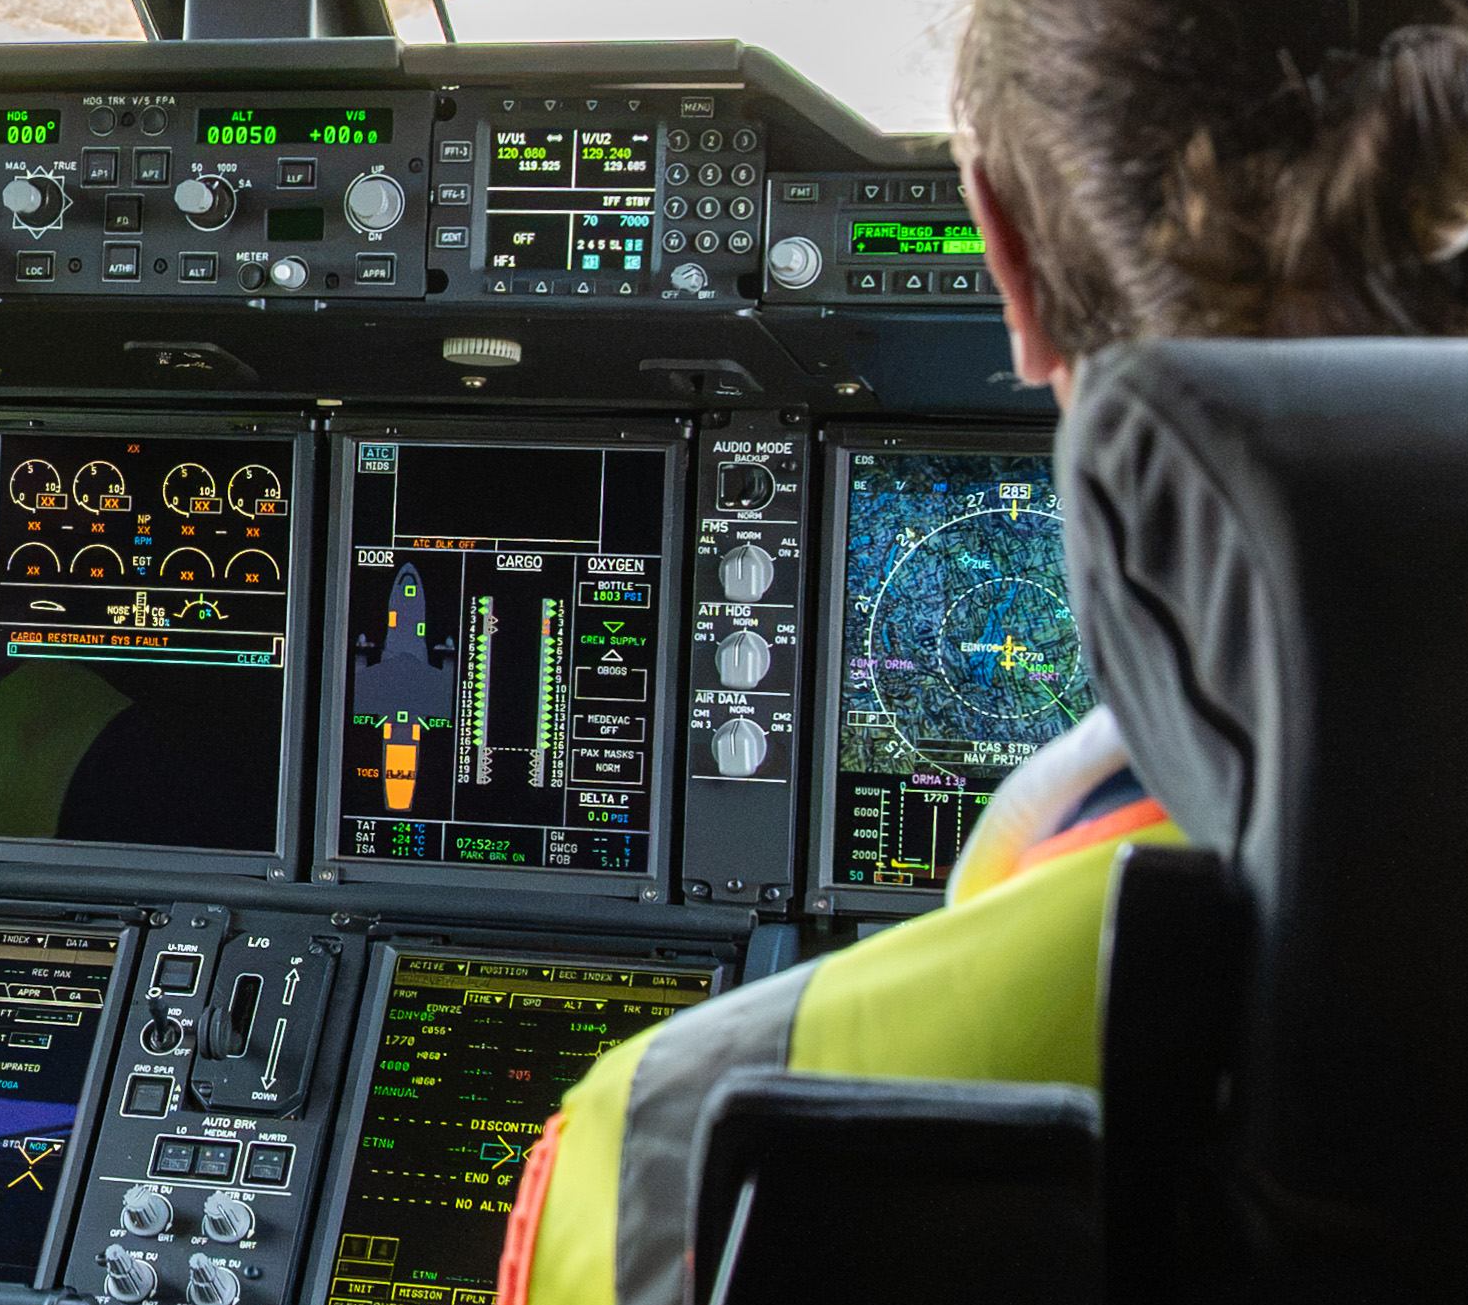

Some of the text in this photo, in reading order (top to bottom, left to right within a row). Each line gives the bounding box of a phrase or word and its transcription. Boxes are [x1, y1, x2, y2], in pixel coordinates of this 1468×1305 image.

[7, 110, 28, 122] HDG
[232, 111, 254, 122] ALT
[346, 110, 366, 121] V/S
[207, 126, 277, 144] 00050
[497, 133, 526, 144] V/U1
[582, 133, 612, 145] V/U2
[582, 148, 632, 160] 129.240
[53, 160, 77, 171] TRUE
[620, 214, 650, 228] 7000
[513, 233, 535, 245] OFF
[236, 251, 269, 263] METER
[494, 255, 516, 268] HF1
[367, 448, 389, 459] ATC
[713, 442, 793, 455] AUDIO MODE
[366, 461, 390, 471] MIDS
[776, 484, 797, 493] TACT
[1002, 485, 1028, 498] 285
[137, 515, 151, 525] NP
[702, 521, 728, 533] FMS
[413, 539, 476, 550] ATC DLK OFF
[132, 556, 152, 567] EGT
[358, 551, 395, 564] DOOR
[496, 556, 543, 570] CARGO
[587, 558, 645, 573] OXYGEN
[598, 581, 634, 592] BOTTLE
[107, 606, 130, 616] NOSE
[152, 608, 165, 619] CG
[699, 605, 751, 617] ATT HDG
[113, 615, 126, 626] UP
[11, 631, 169, 648] CARGO RESTRAINT SYS FAULT
[237, 654, 270, 665] CLEAR
[695, 693, 747, 706] AIR DATA
[587, 715, 630, 725] MEDEVAC
[600, 726, 618, 735] OFF
[972, 742, 1004, 753] TCAS
[580, 749, 634, 760] PAX MASKS
[596, 763, 620, 774] NORM
[580, 794, 629, 805] DELTA P
[854, 807, 879, 818] 6000
[356, 821, 377, 831] TAT
[355, 832, 375, 843] SAT
[853, 829, 878, 840] 4000
[356, 844, 376, 855] ISA
[456, 838, 510, 851] 07:52:27
[66, 938, 89, 949] DATA
[248, 937, 270, 950] L/G
[252, 1092, 277, 1101] DOWN
[202, 1117, 257, 1131] AUTO BRK
[455, 1198, 512, 1213] NO ALTN
[398, 1289, 443, 1302] MISSION
